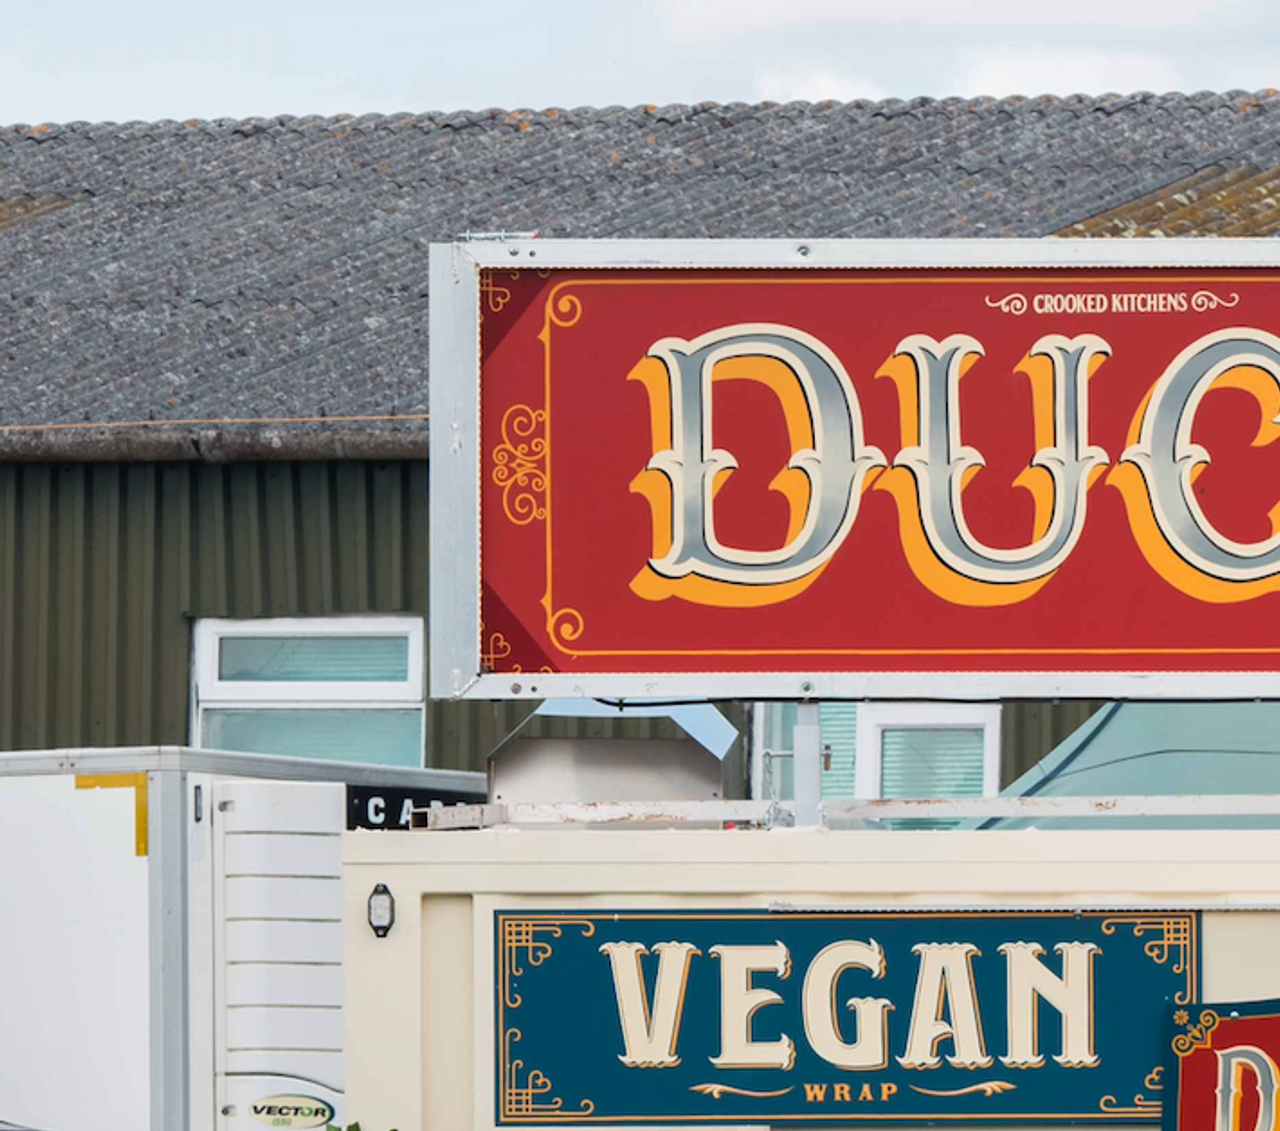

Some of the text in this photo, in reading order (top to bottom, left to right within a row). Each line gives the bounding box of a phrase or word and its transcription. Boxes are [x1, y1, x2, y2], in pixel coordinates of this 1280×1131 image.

[1033, 292, 1188, 313] CROOKED KITCHENS
[598, 939, 1102, 1071] VEGAN
[803, 1082, 898, 1102] WRAP
[253, 1105, 326, 1117] VECTOR
